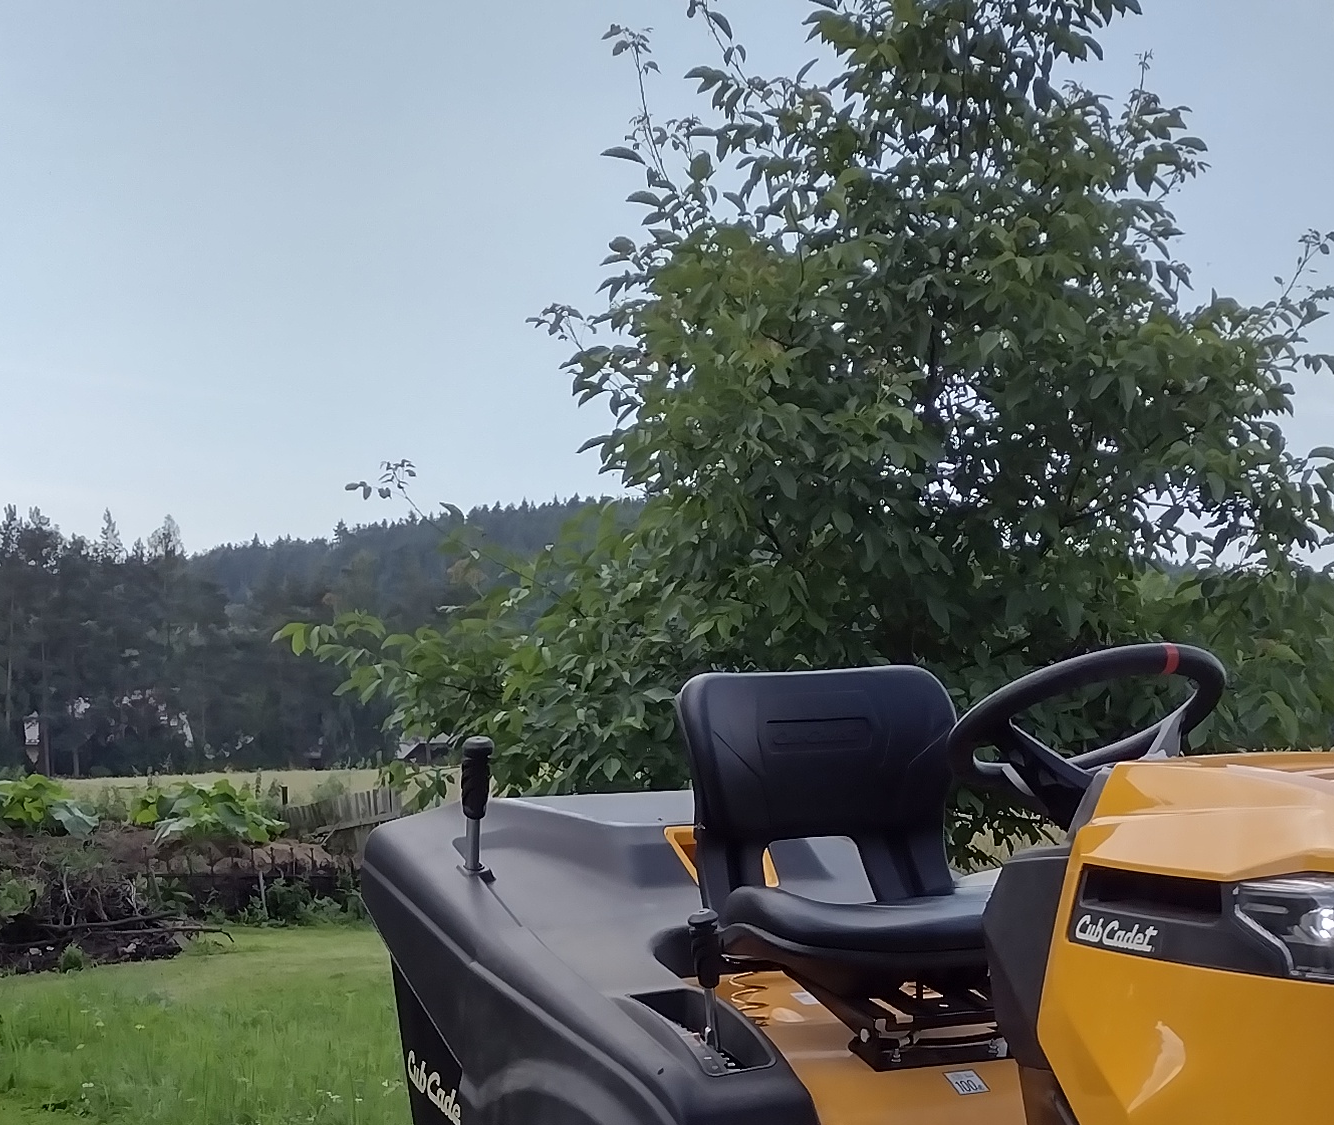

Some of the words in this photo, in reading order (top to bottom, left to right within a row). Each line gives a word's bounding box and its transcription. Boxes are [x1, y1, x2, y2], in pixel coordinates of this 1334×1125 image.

[1075, 914, 1105, 943] Cub
[1102, 920, 1159, 952] Cadet
[407, 1049, 427, 1094] Cub
[954, 1079, 978, 1093] 100
